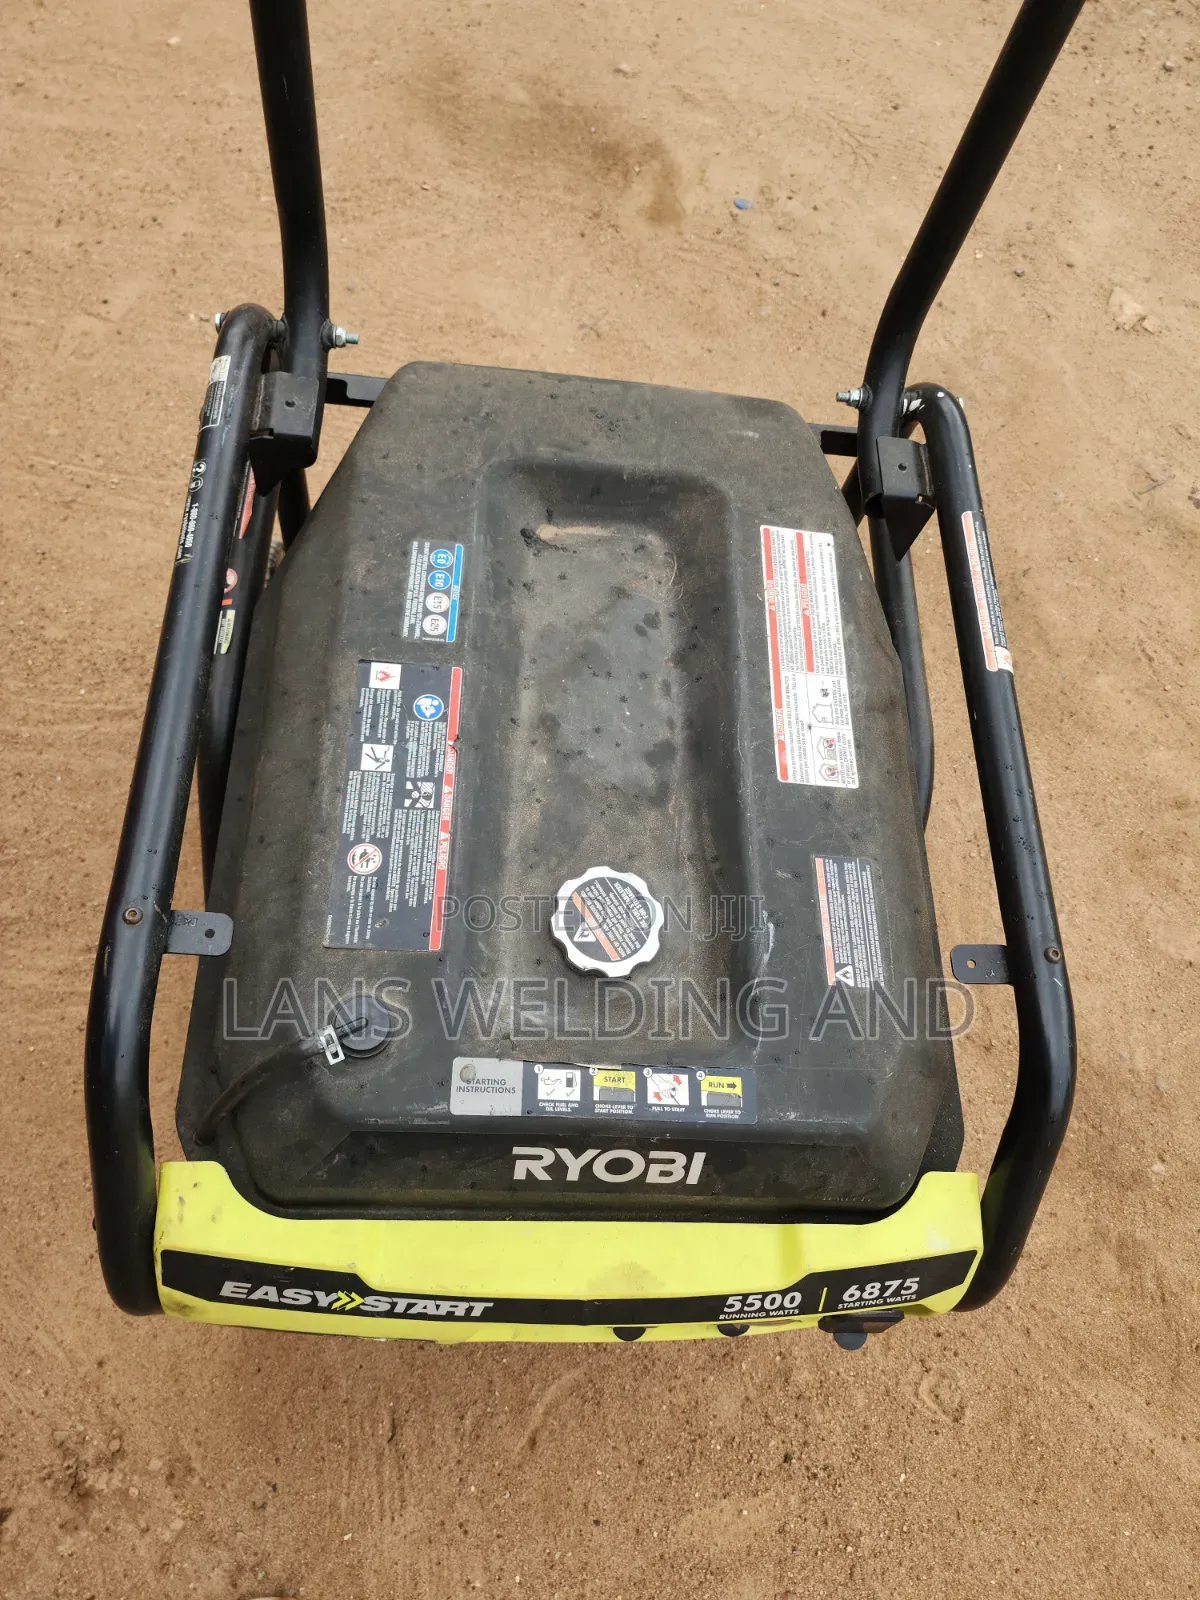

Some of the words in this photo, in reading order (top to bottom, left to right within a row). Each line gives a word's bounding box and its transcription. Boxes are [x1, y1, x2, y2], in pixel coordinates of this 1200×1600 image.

[436, 553, 446, 564] E0
[434, 573, 444, 586] E10
[432, 596, 442, 609] E15
[429, 618, 439, 631] E25
[446, 748, 455, 774] DANGER
[442, 794, 451, 820] DANGER
[438, 841, 447, 869] PELIGRO
[466, 1077, 506, 1085] STARTING
[603, 1074, 625, 1082] START
[455, 1085, 515, 1094] INSTRUCTIONS
[512, 1146, 706, 1185] RYOBI
[842, 1277, 920, 1302] 6875
[219, 1281, 338, 1309] EASY
[362, 1295, 494, 1317] START
[723, 1291, 802, 1313] 5500
[837, 1298, 884, 1310] STARTING
[886, 1294, 917, 1304] WATTS
[719, 1311, 766, 1320] RUNNING
[769, 1308, 799, 1316] WATTS
